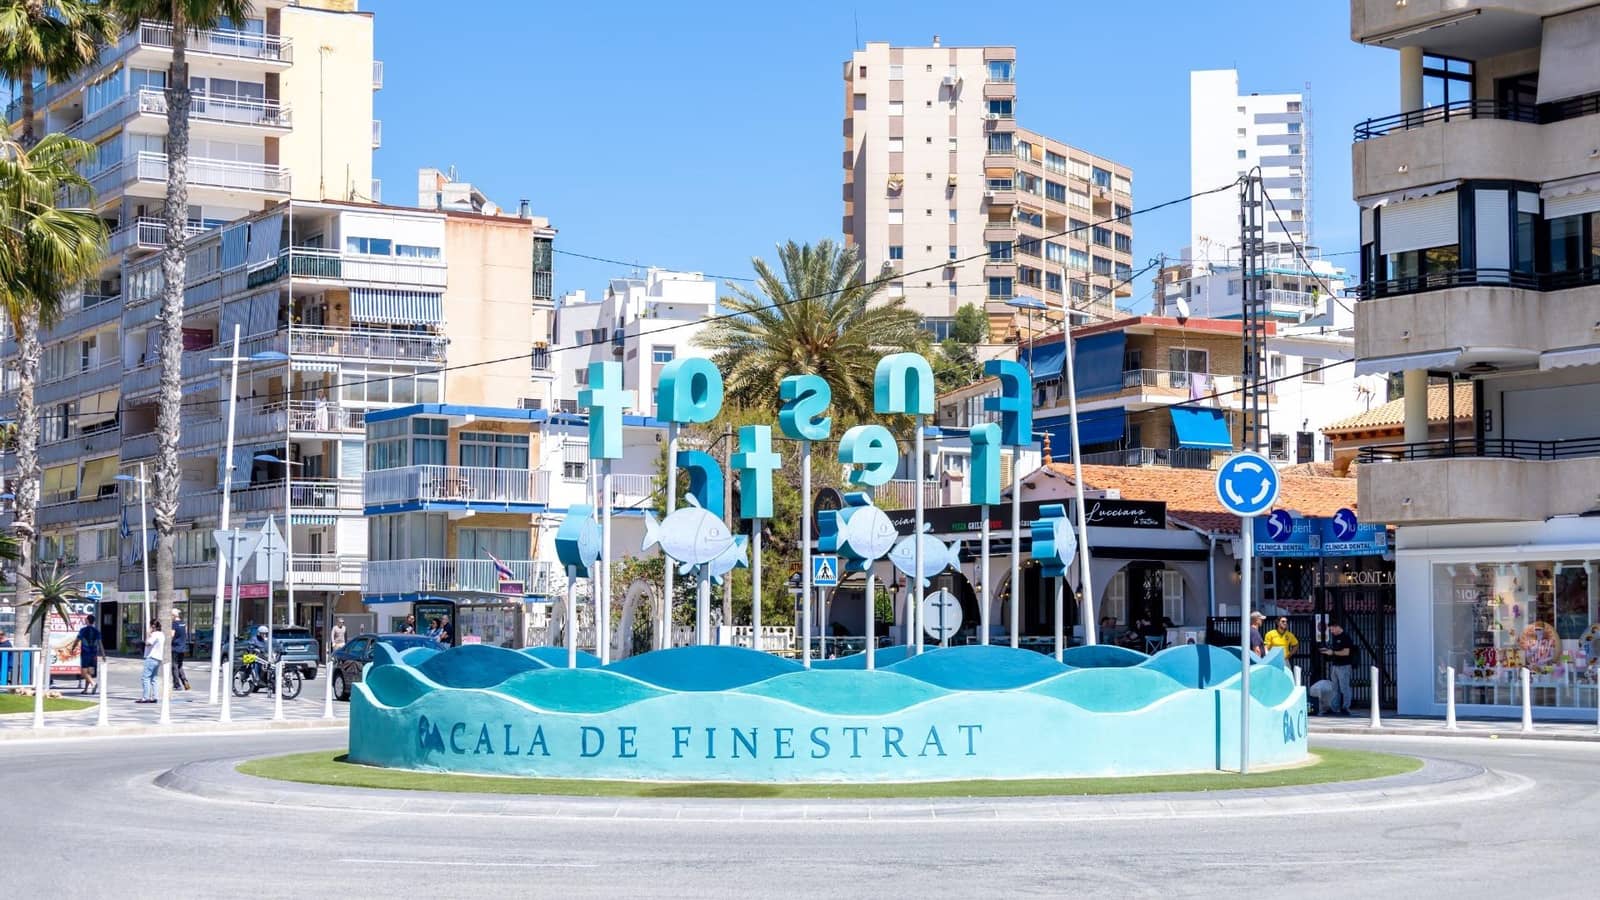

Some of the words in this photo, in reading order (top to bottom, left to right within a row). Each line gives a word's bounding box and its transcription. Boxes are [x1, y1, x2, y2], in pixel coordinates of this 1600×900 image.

[1085, 502, 1146, 523] Lucciano
[1344, 570, 1383, 584] FRONT
[450, 722, 550, 756] CALA
[580, 726, 638, 757] DE
[671, 724, 983, 759] FINESTRAT
